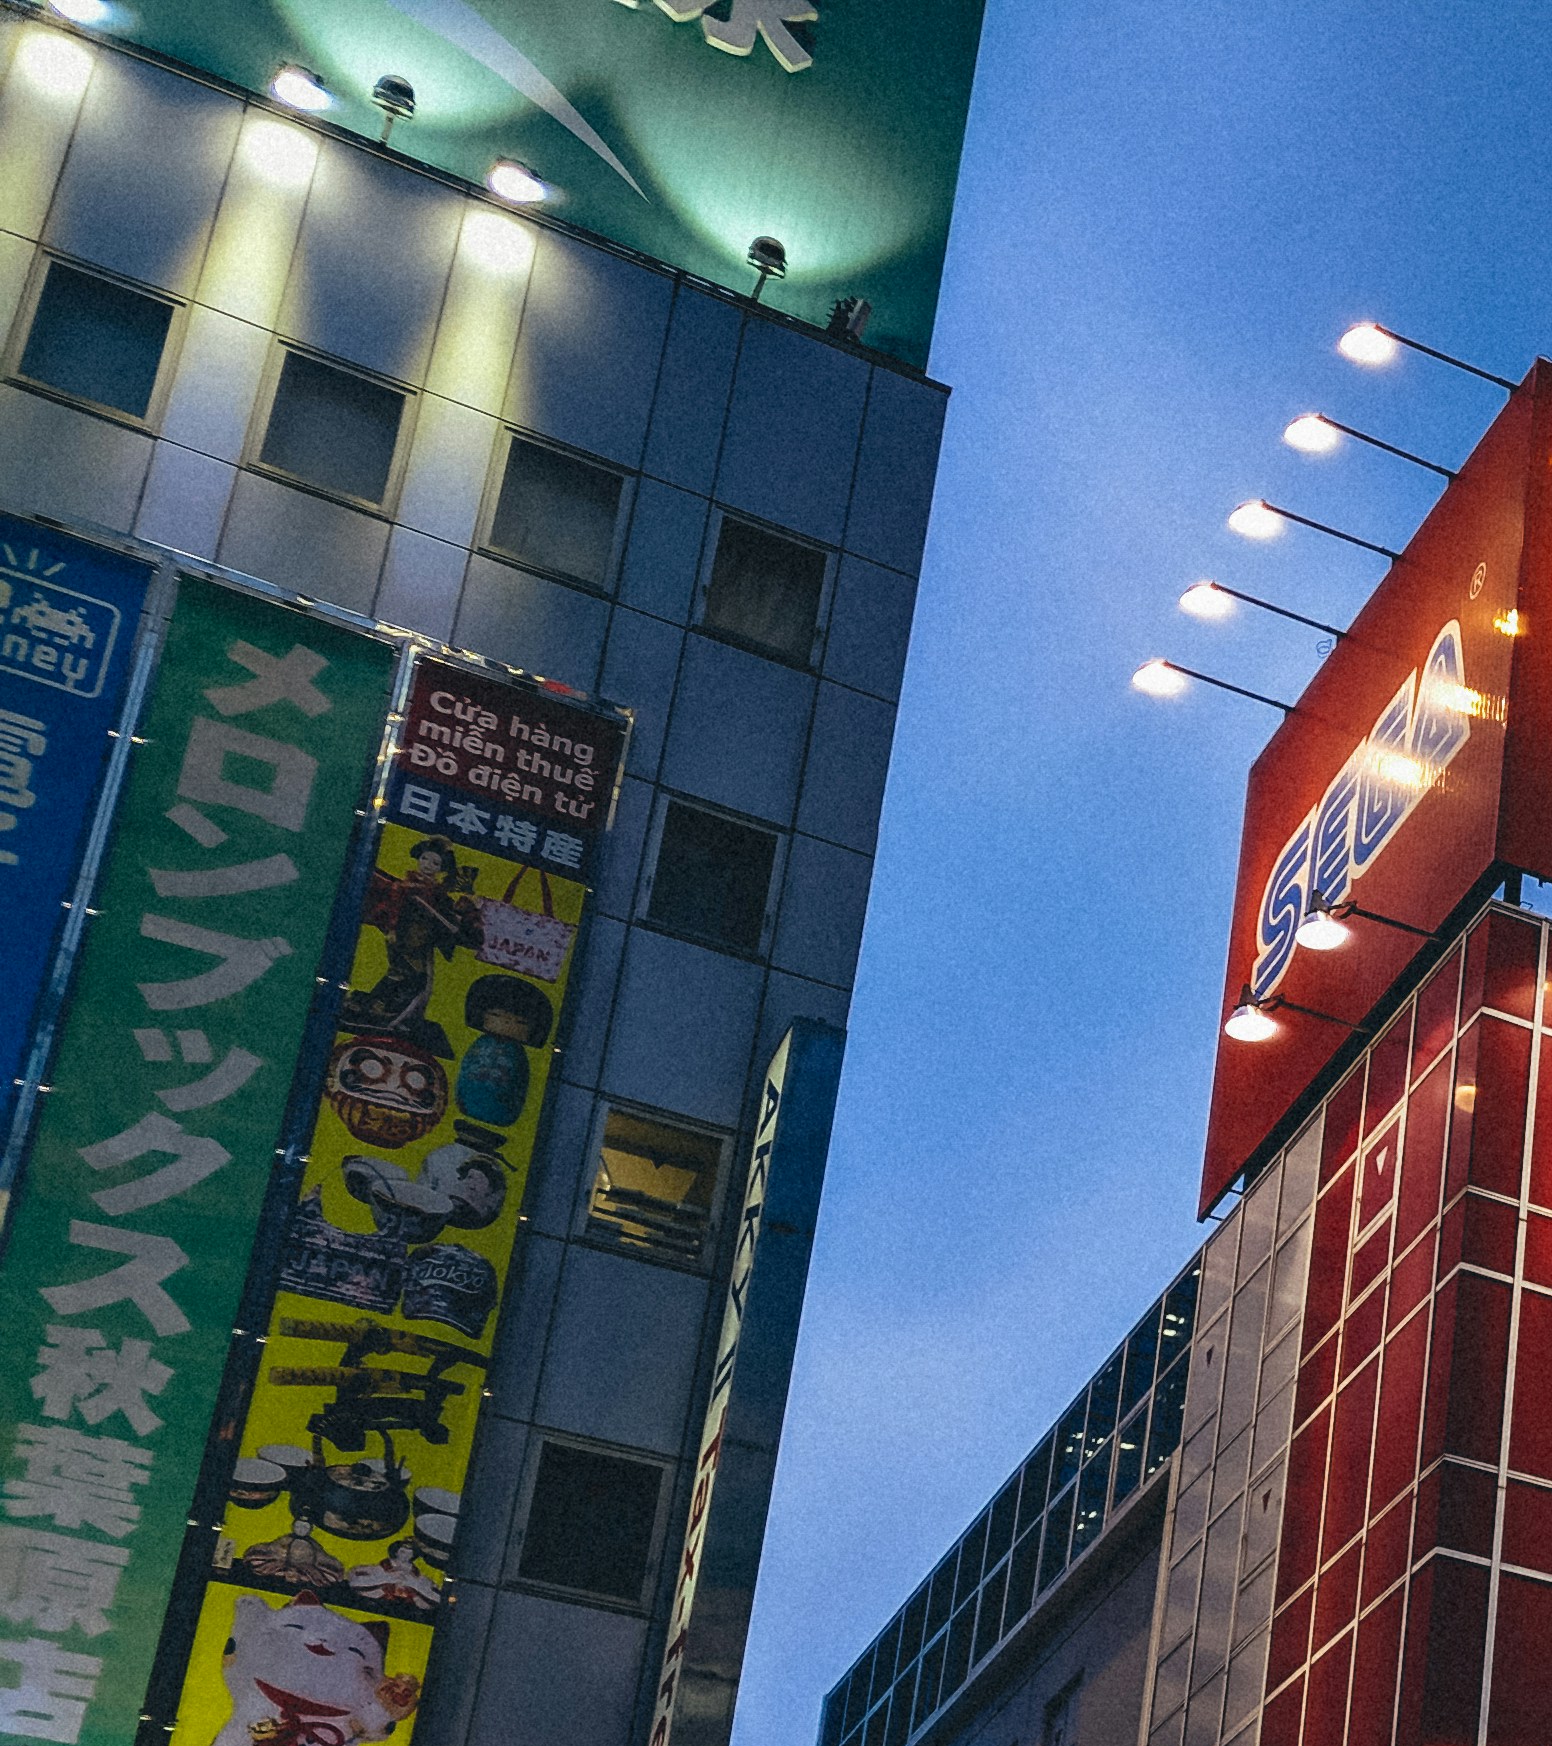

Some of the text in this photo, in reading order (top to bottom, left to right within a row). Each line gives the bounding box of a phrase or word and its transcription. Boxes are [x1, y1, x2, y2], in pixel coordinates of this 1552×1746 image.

[418, 715, 599, 792] miễn thuế
[429, 689, 595, 767] Cửa hàng
[409, 740, 460, 777] Đồ
[468, 762, 543, 808] điện
[1252, 619, 1470, 1000] SEGA
[399, 782, 585, 869] 日本特産
